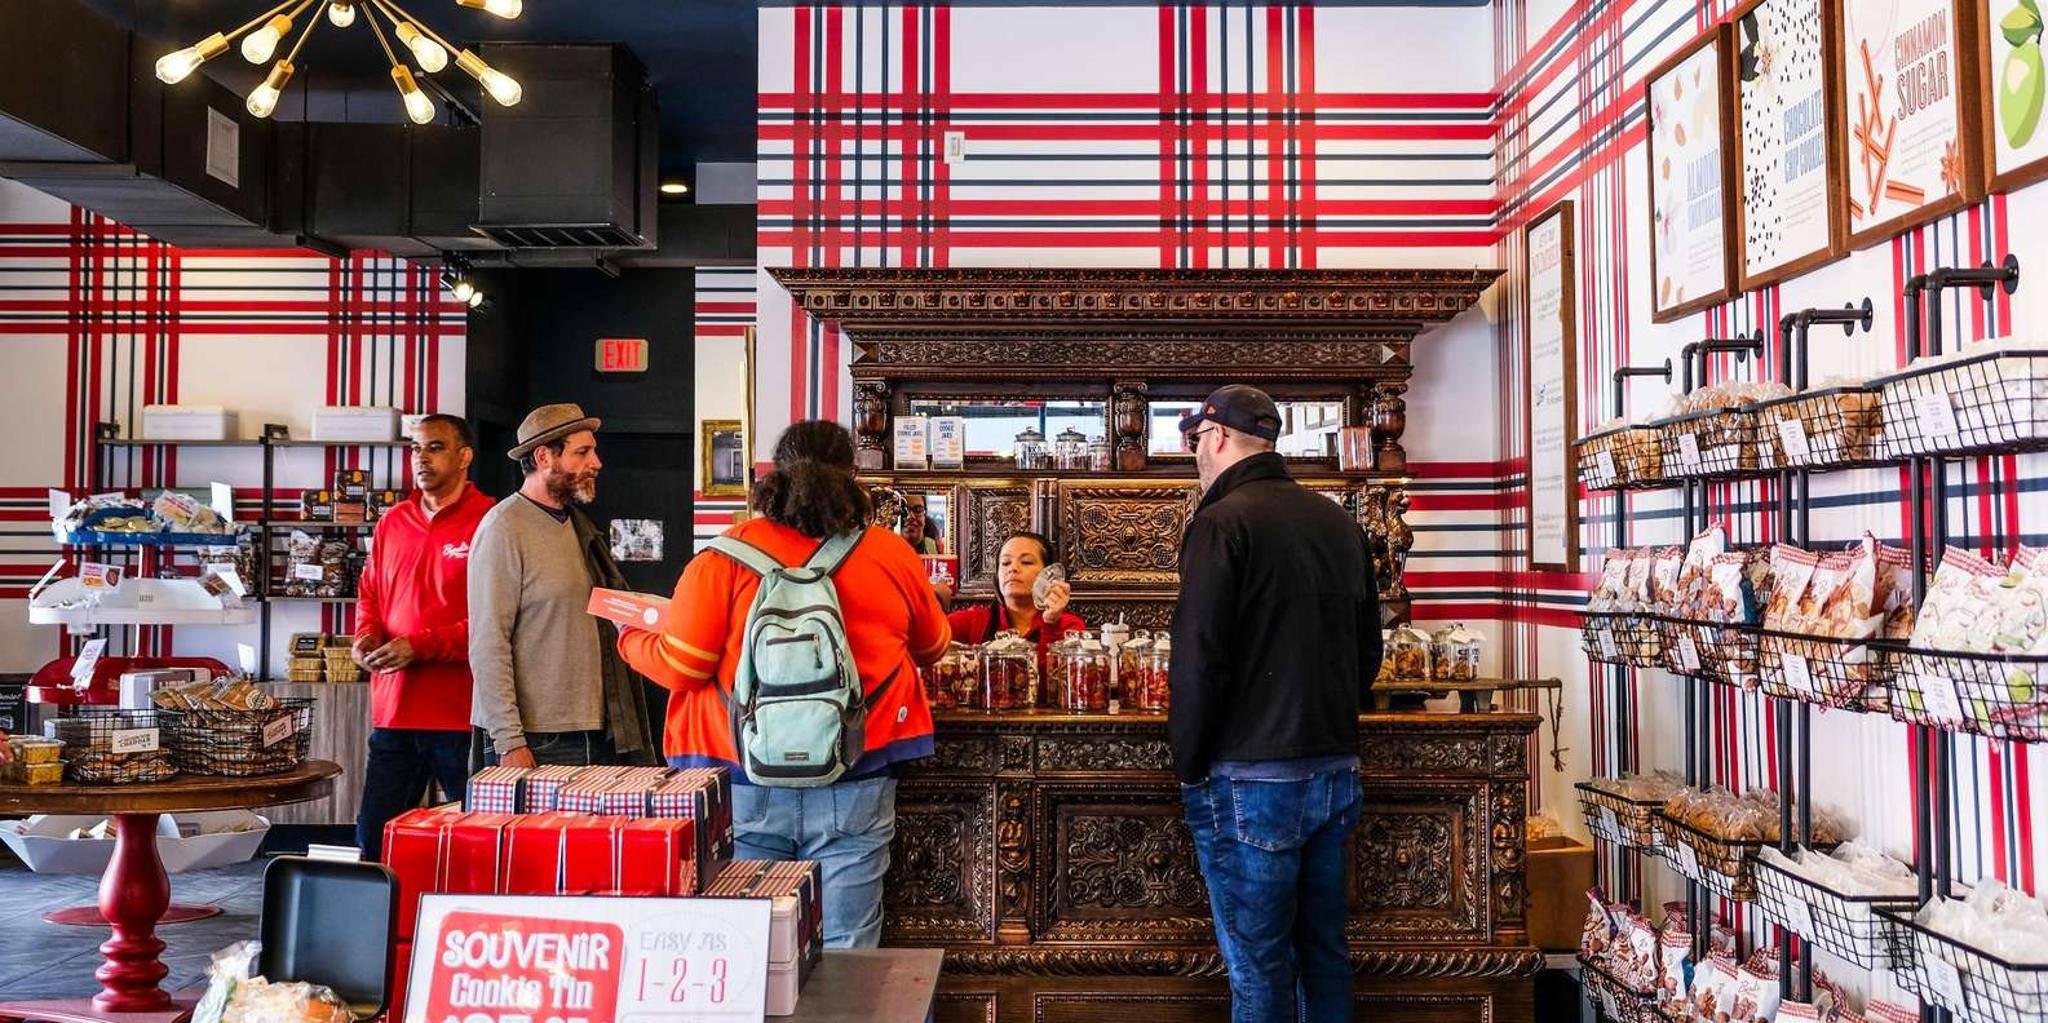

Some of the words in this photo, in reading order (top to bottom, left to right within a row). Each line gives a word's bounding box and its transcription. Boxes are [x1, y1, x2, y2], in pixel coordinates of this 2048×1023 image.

[1894, 8, 1947, 72] CINNAMON
[1896, 50, 1949, 121] SUGAR
[603, 340, 641, 369] EXIT
[640, 931, 692, 955] EASY
[450, 973, 543, 1008] Cookie
[549, 973, 593, 1009] Tin
[636, 957, 727, 1004] 1-2-3
